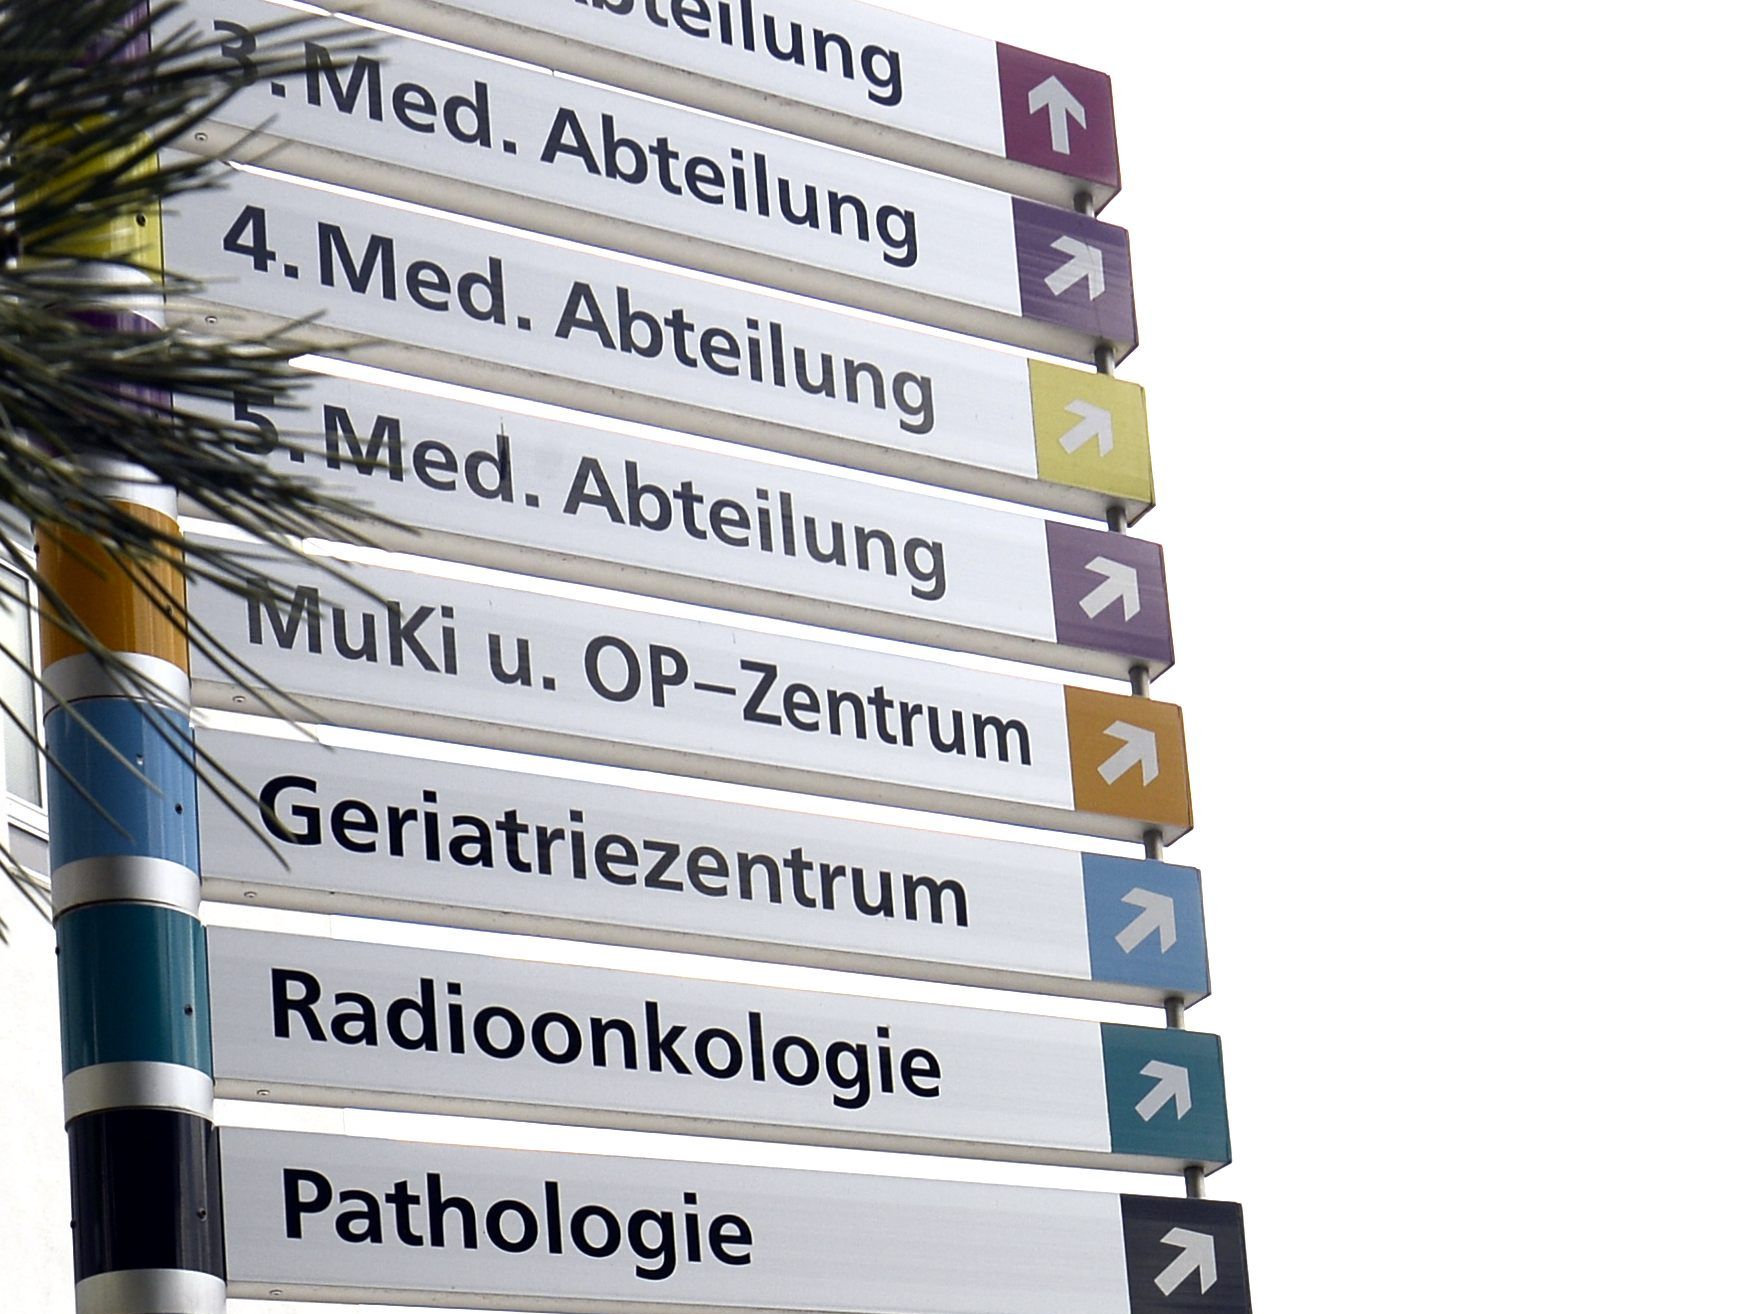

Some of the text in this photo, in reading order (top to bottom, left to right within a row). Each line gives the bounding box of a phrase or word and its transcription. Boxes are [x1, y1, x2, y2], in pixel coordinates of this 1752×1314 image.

[573, 0, 902, 107] teilung
[304, 41, 517, 155] Med.
[540, 107, 918, 268] Abteilung
[223, 205, 934, 435] 4. Med. Abteilung
[323, 404, 539, 508] Med.
[563, 456, 946, 601] Abteilung
[246, 578, 458, 675] MuKi
[488, 633, 556, 691] u.
[258, 775, 968, 927] Geriatriezentrum
[271, 967, 941, 1106] Radioonkologie
[282, 1167, 753, 1281] Pathologie
